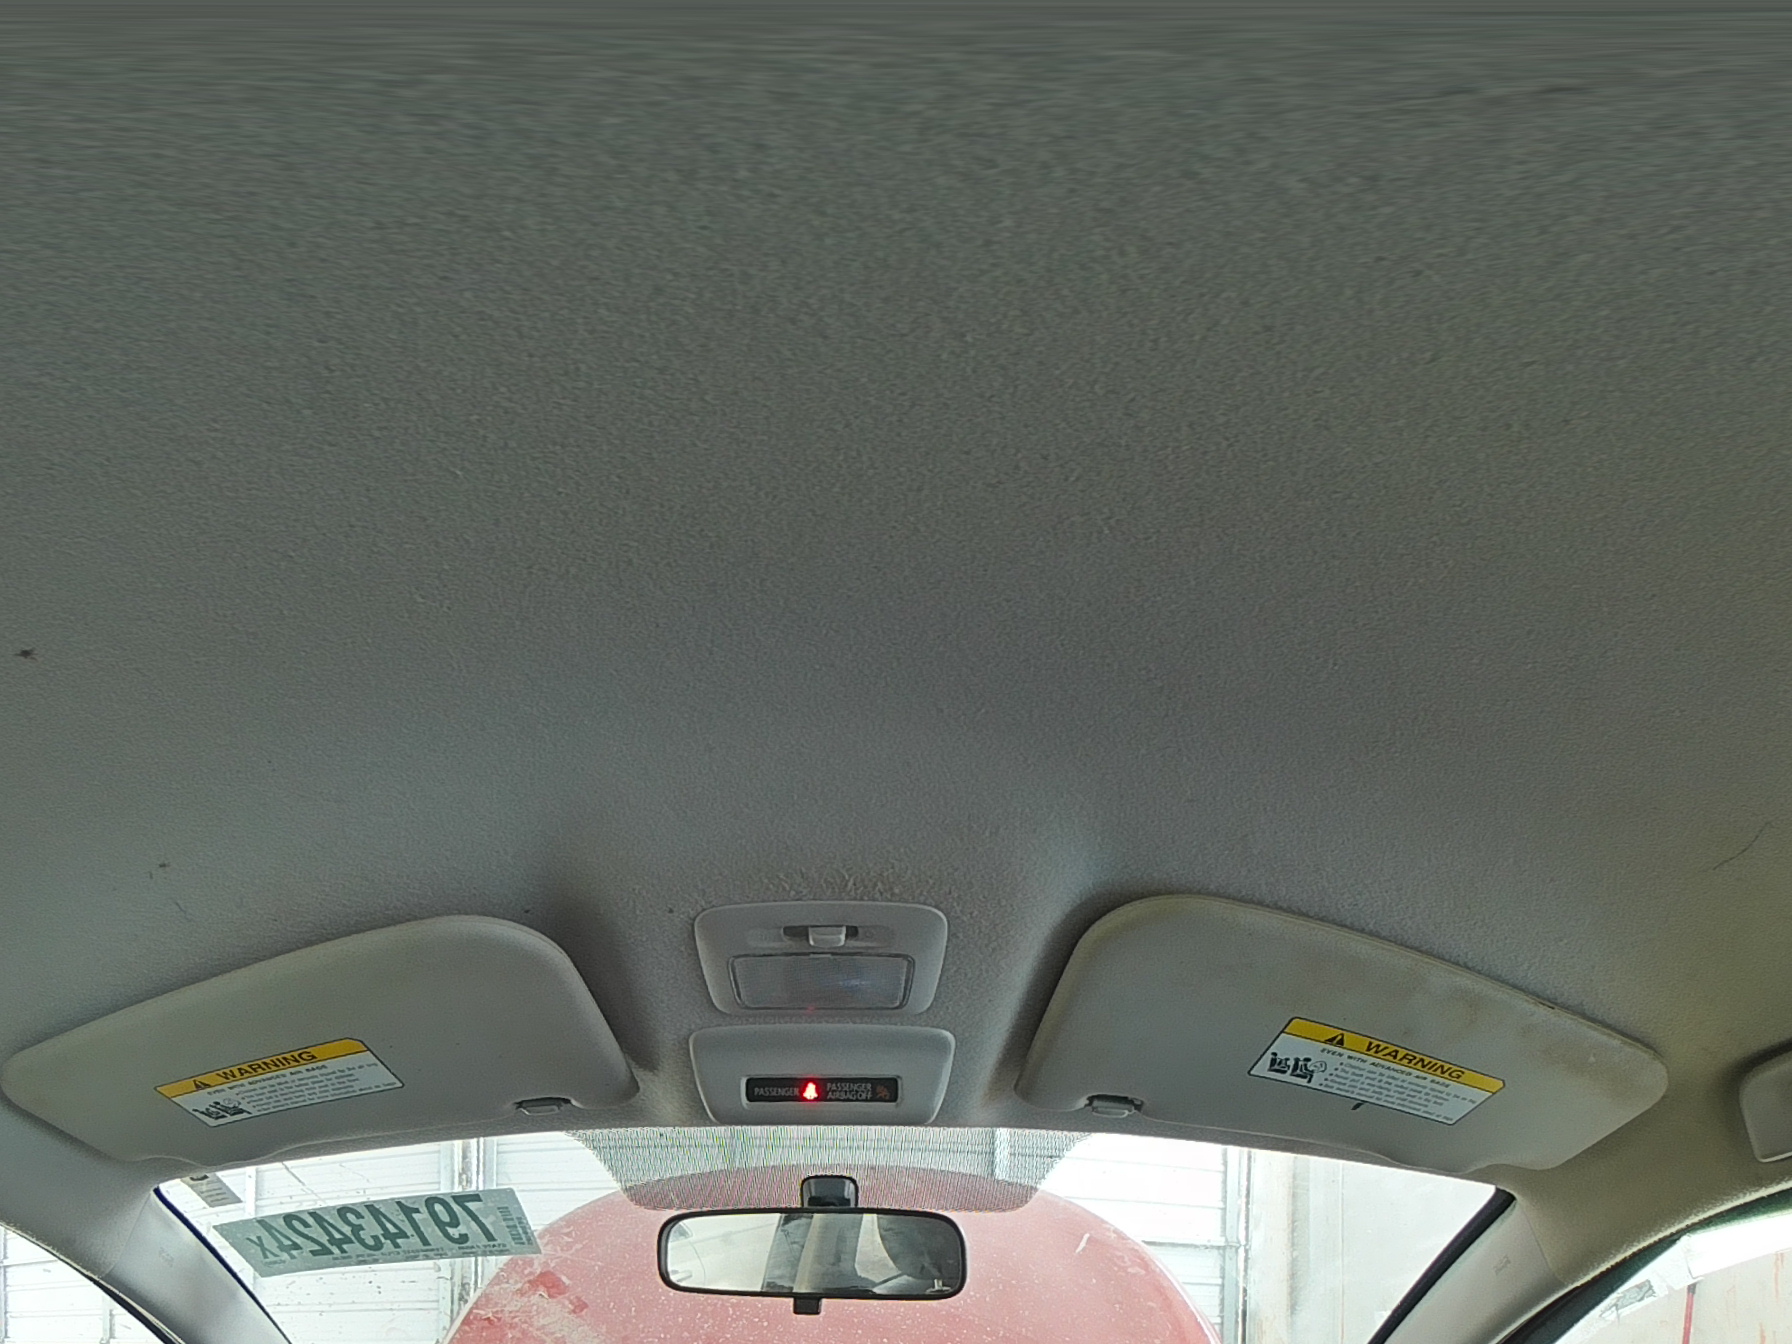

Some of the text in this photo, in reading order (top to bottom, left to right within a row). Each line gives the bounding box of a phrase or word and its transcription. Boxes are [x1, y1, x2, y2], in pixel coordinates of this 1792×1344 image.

[1320, 1047, 1344, 1058] EVEN
[1347, 1054, 1367, 1063] WITH
[1364, 1040, 1465, 1080] WARNING
[215, 1051, 317, 1081] WARNING
[753, 1087, 800, 1097] PASSENGER
[826, 1082, 872, 1091] PASSENGER
[826, 1090, 872, 1100] AIRBAG OFF
